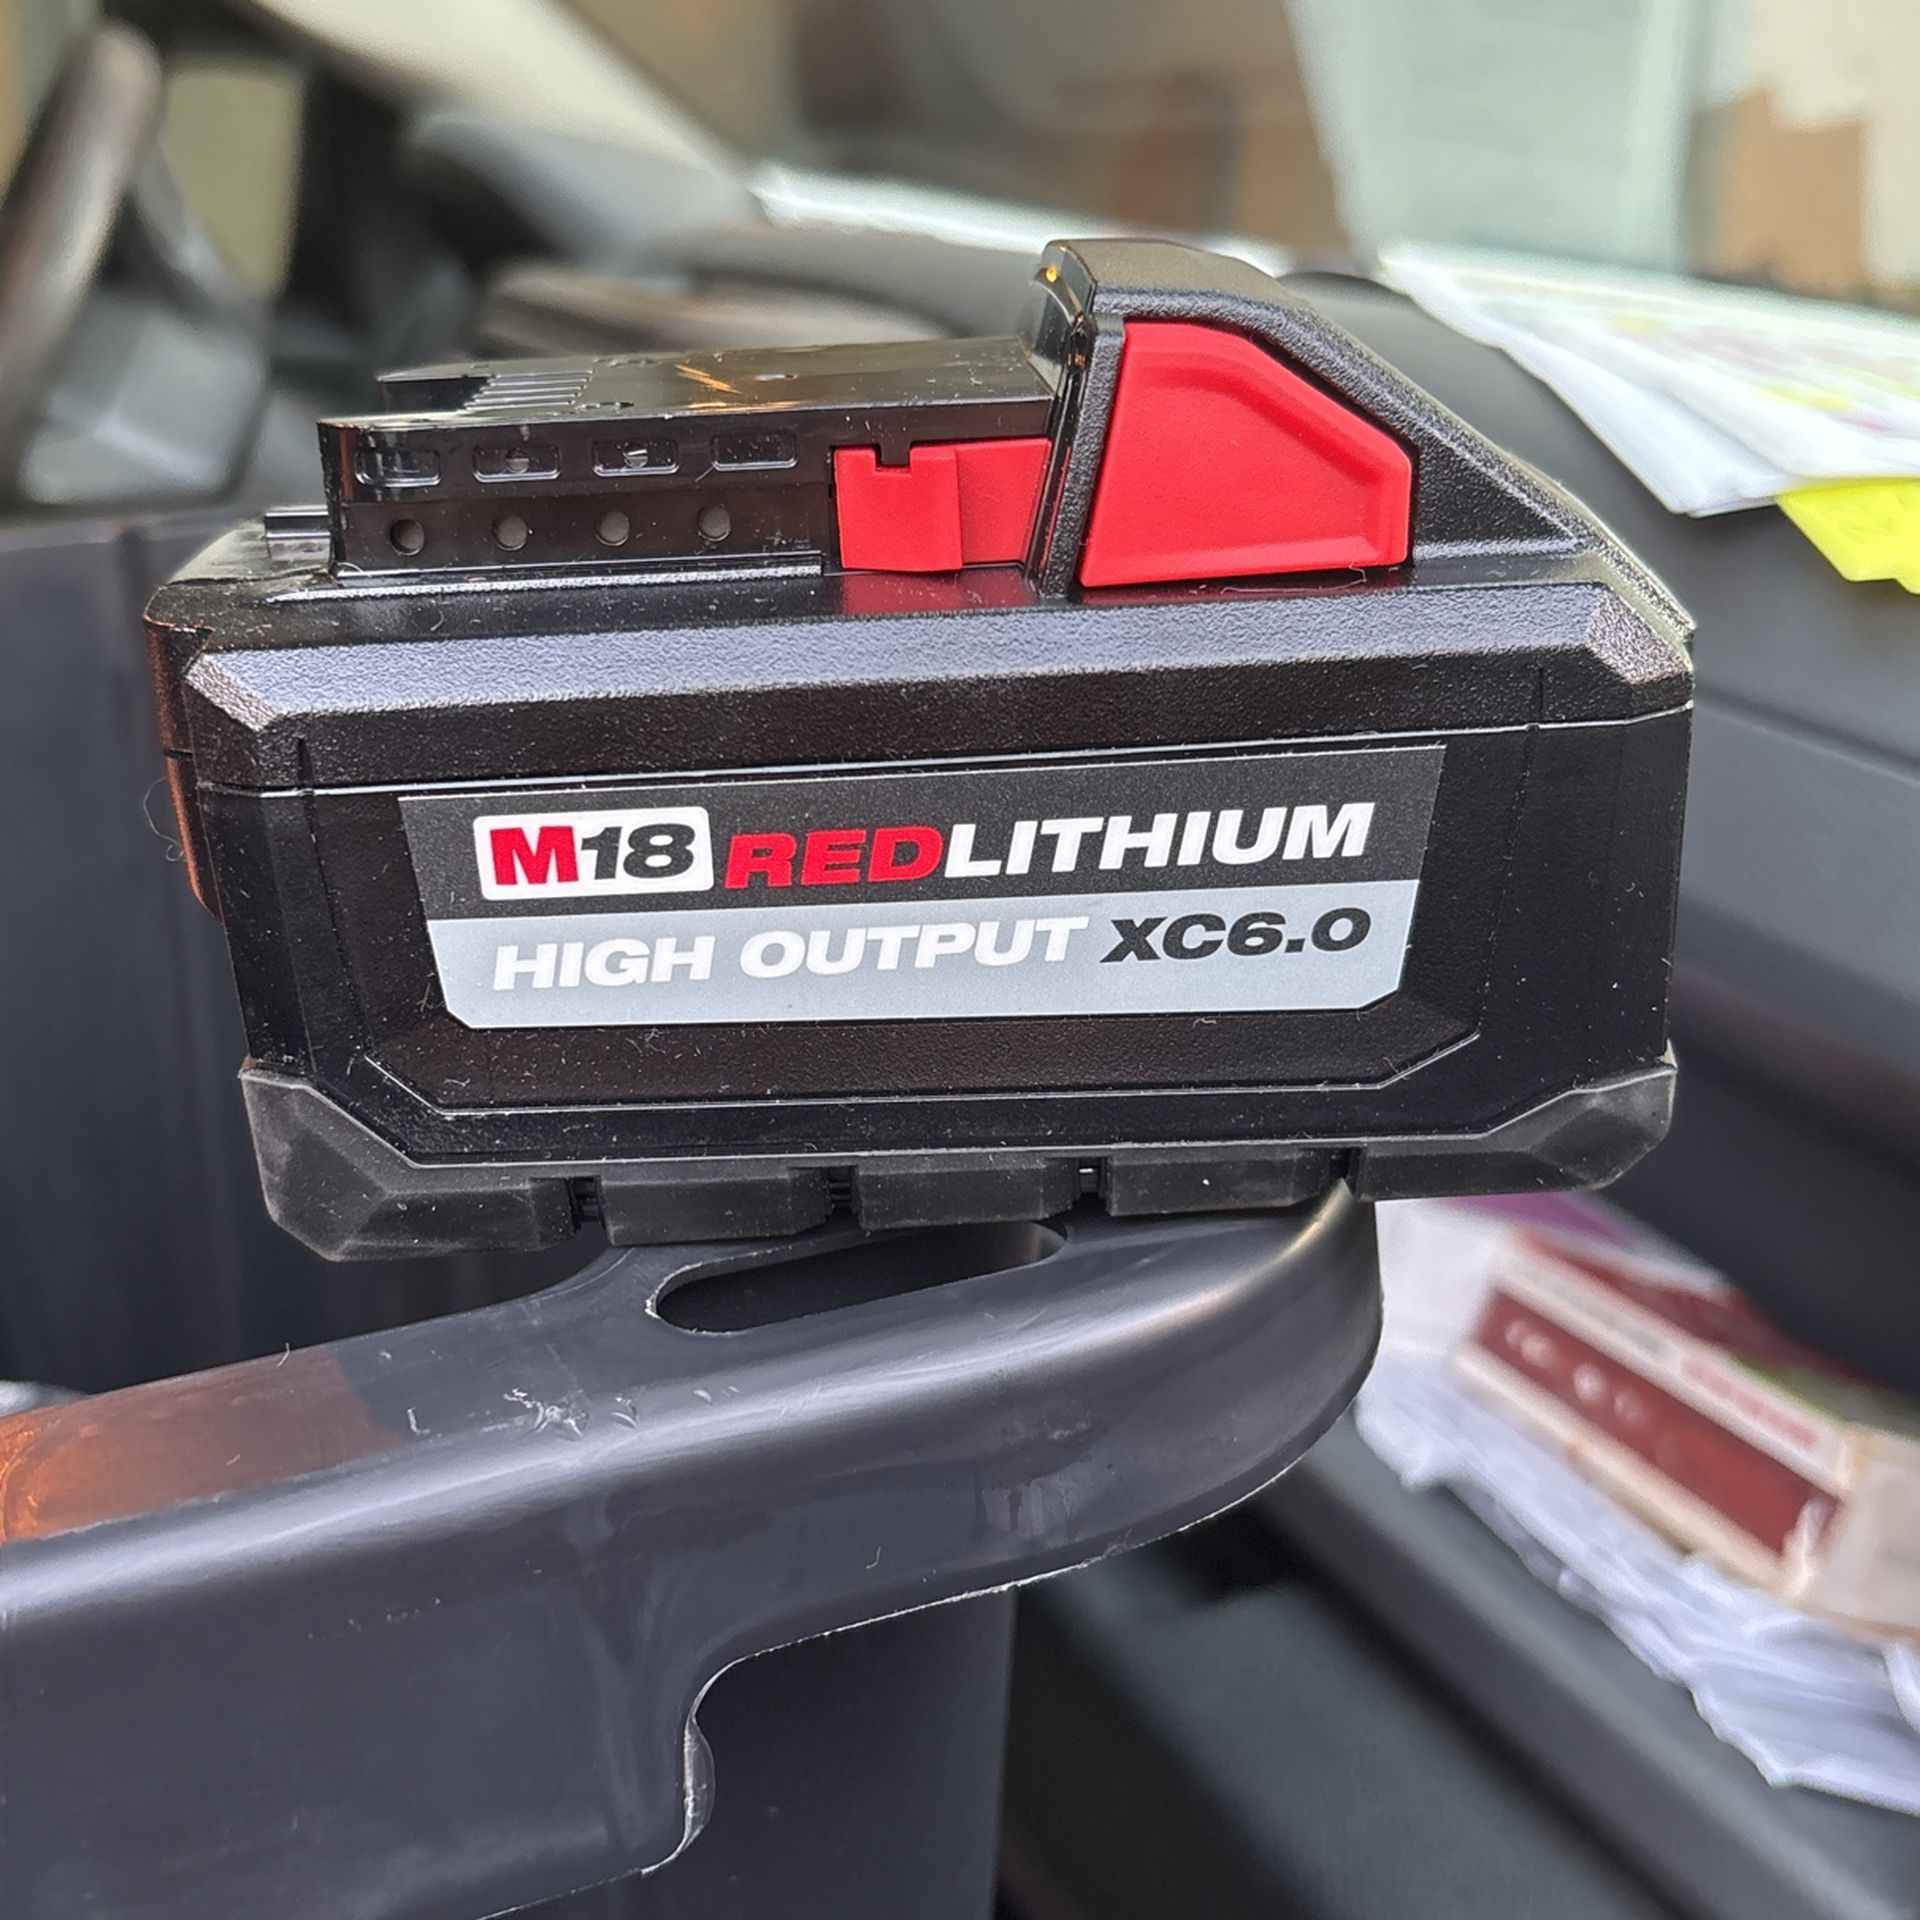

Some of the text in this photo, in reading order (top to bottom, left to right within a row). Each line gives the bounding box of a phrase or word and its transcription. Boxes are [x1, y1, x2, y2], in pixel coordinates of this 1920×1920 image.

[487, 802, 1376, 890] M18 REDLITHIUM
[492, 906, 1371, 991] HIGH OUTPUT XC6.0
